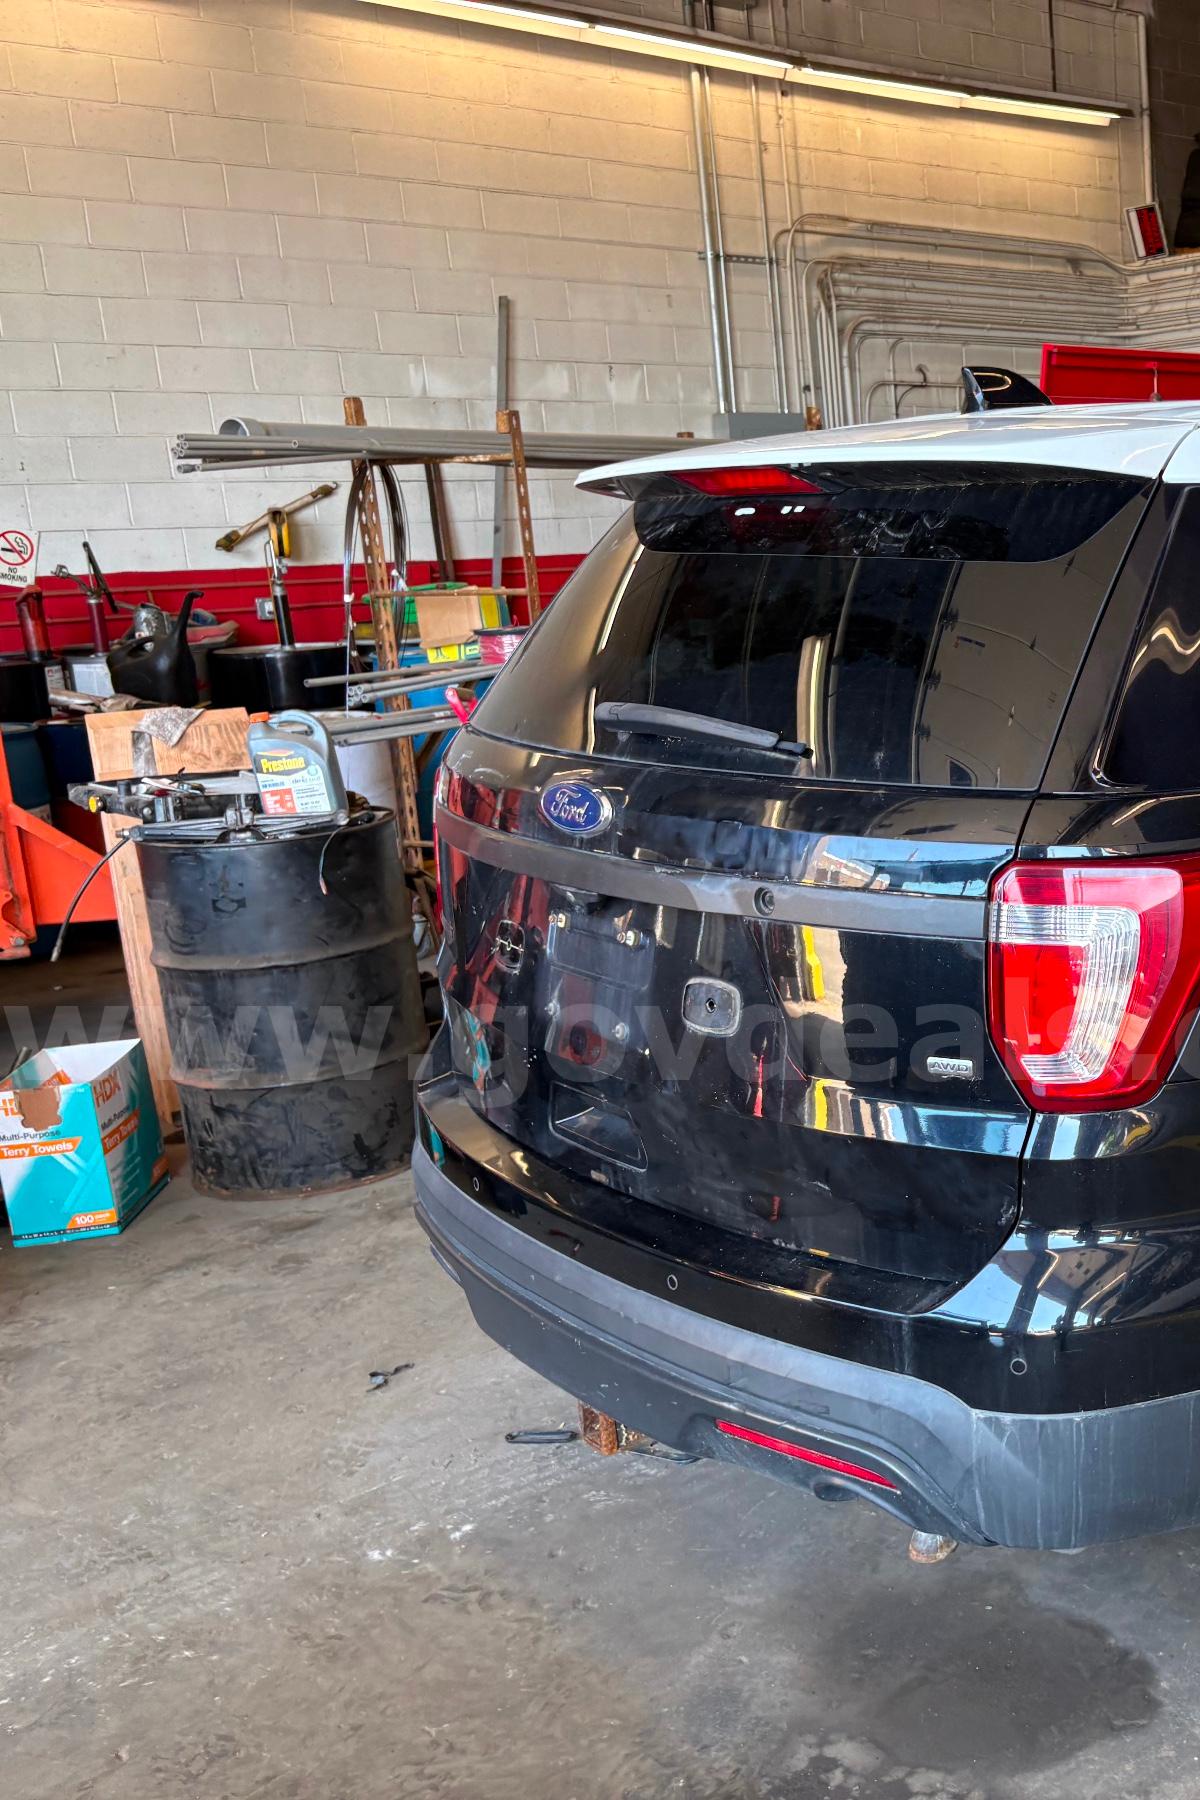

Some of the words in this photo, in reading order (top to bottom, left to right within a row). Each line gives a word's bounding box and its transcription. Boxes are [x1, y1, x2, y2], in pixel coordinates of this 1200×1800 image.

[0, 573, 27, 583] MOKING
[551, 789, 590, 823] Ford
[930, 1062, 968, 1072] AWD
[94, 1069, 121, 1108] HDX
[1, 1147, 29, 1157] Terry
[32, 1141, 73, 1156] Towels
[75, 1213, 94, 1225] 100
